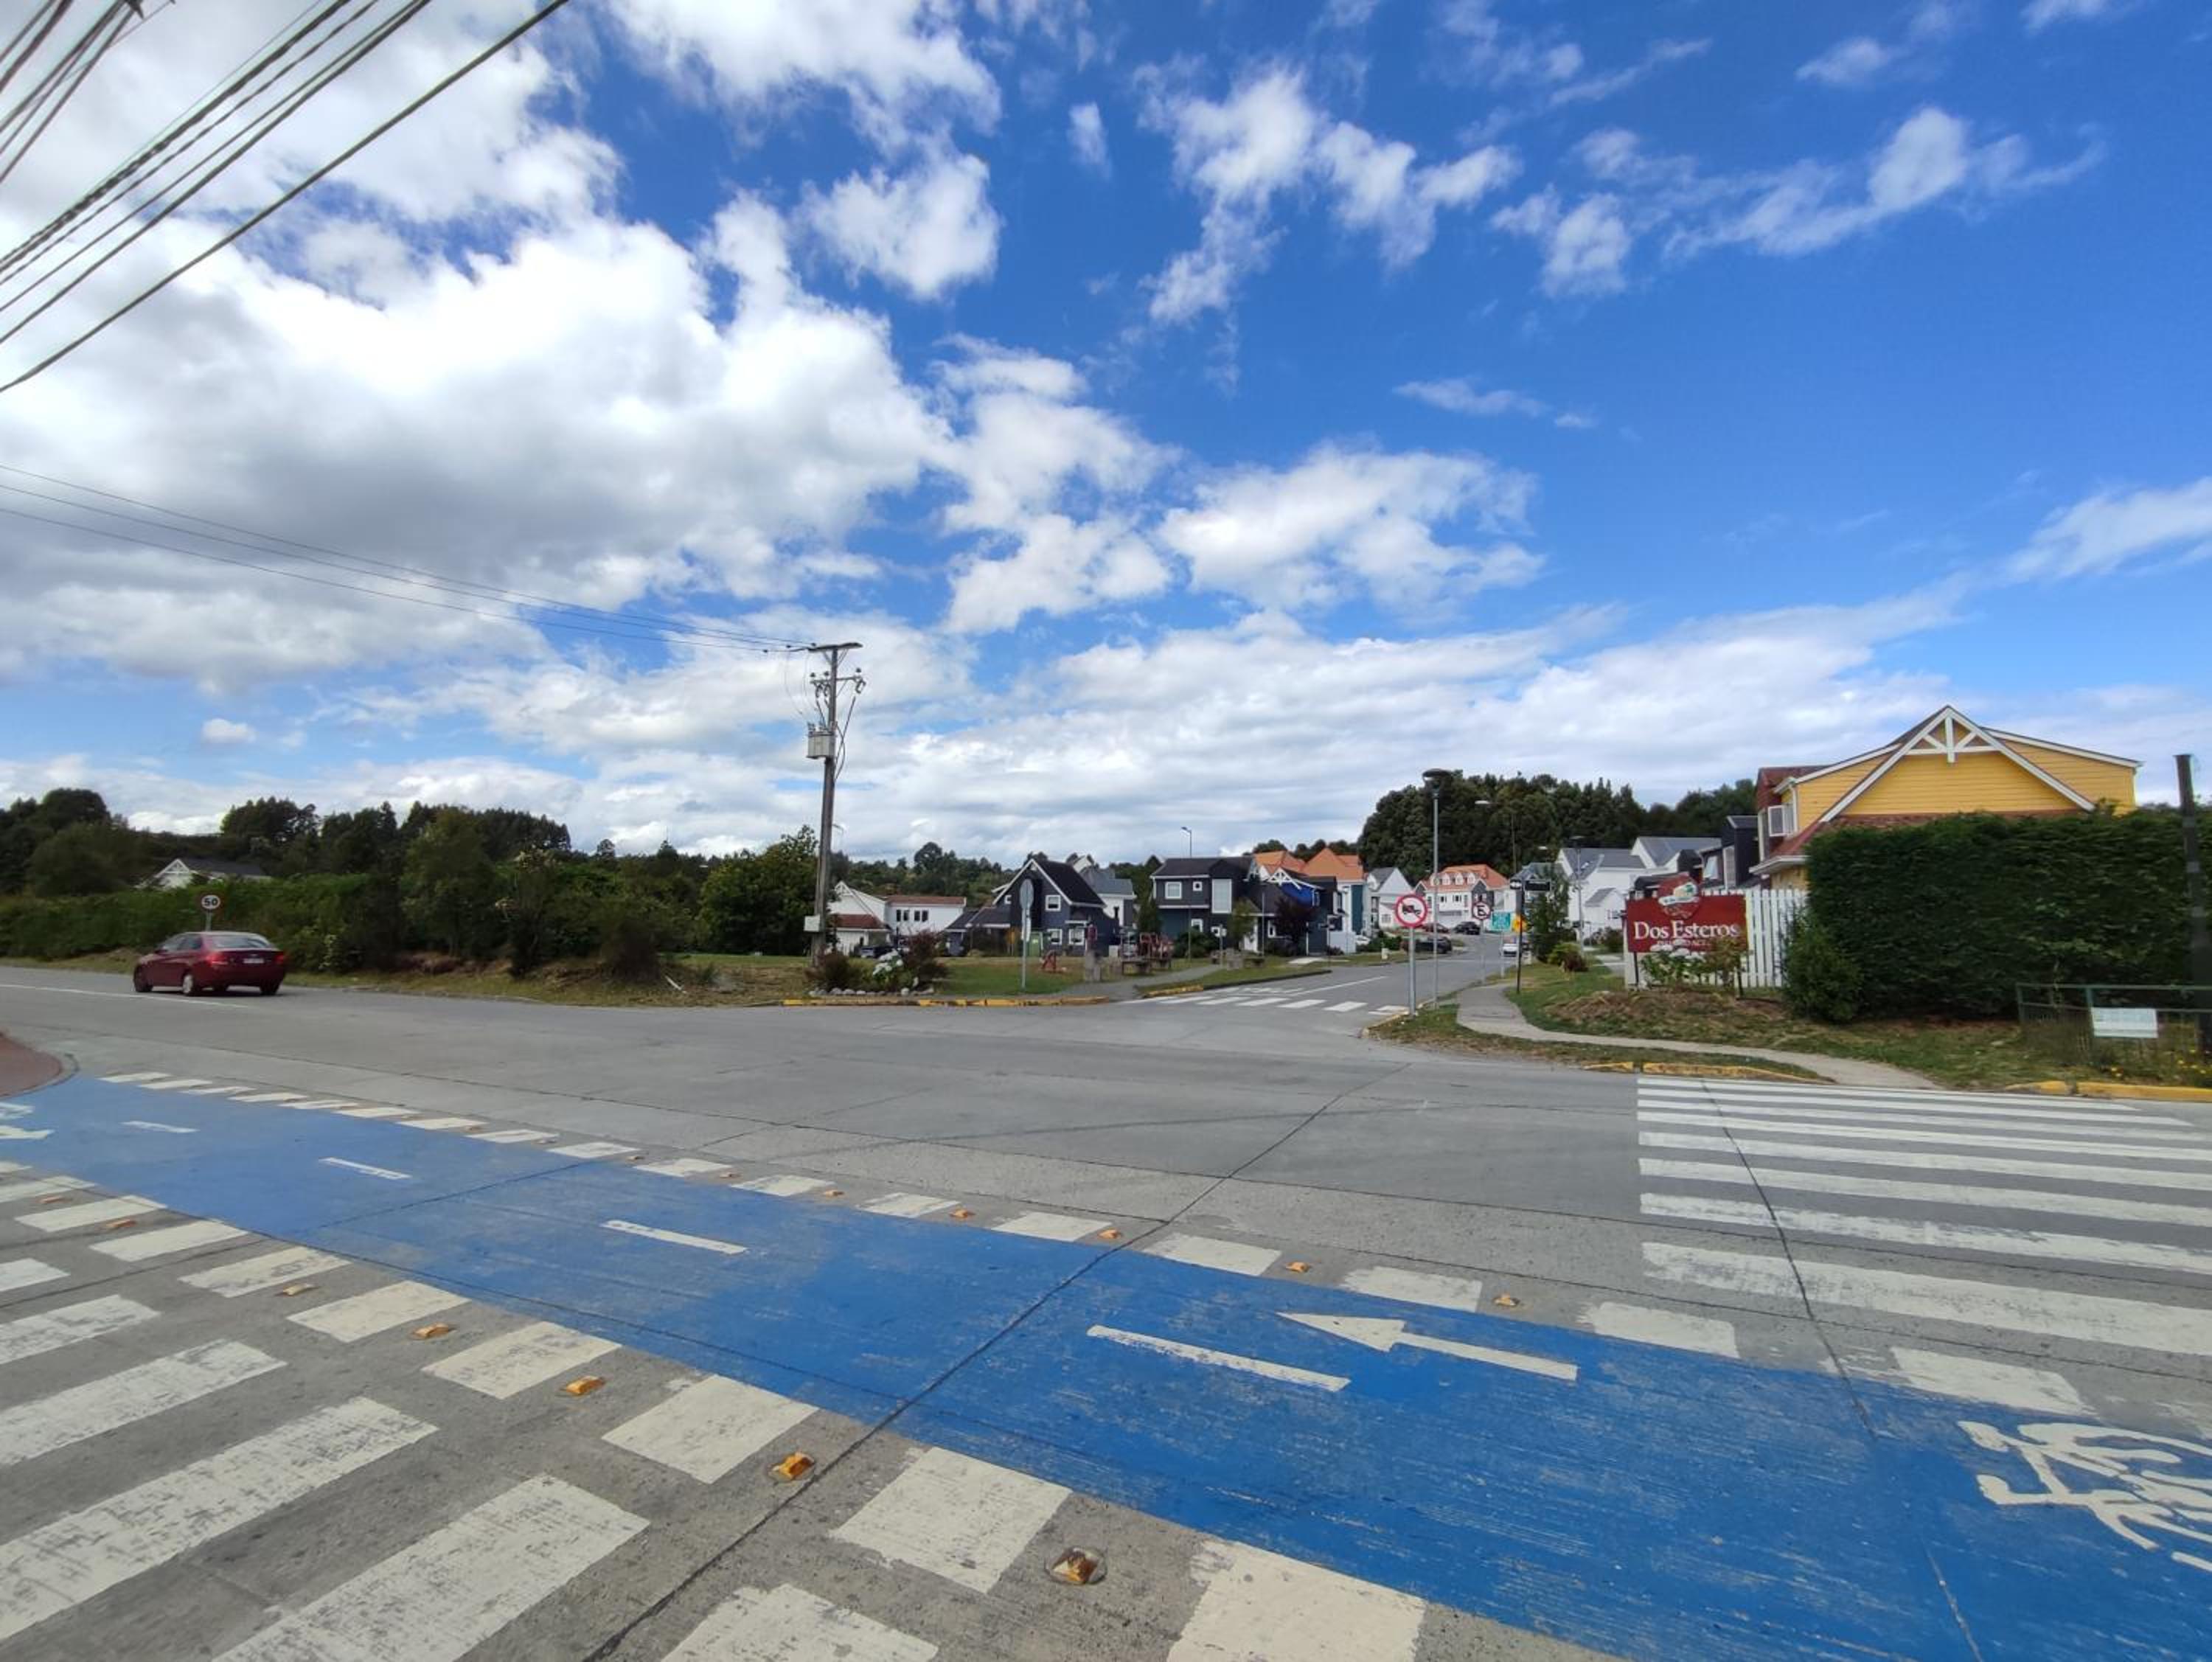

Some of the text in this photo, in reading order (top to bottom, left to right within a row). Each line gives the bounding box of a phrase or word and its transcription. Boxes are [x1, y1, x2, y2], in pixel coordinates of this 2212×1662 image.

[204, 897, 218, 907] 50
[1633, 919, 1741, 940] Dos Esteros
